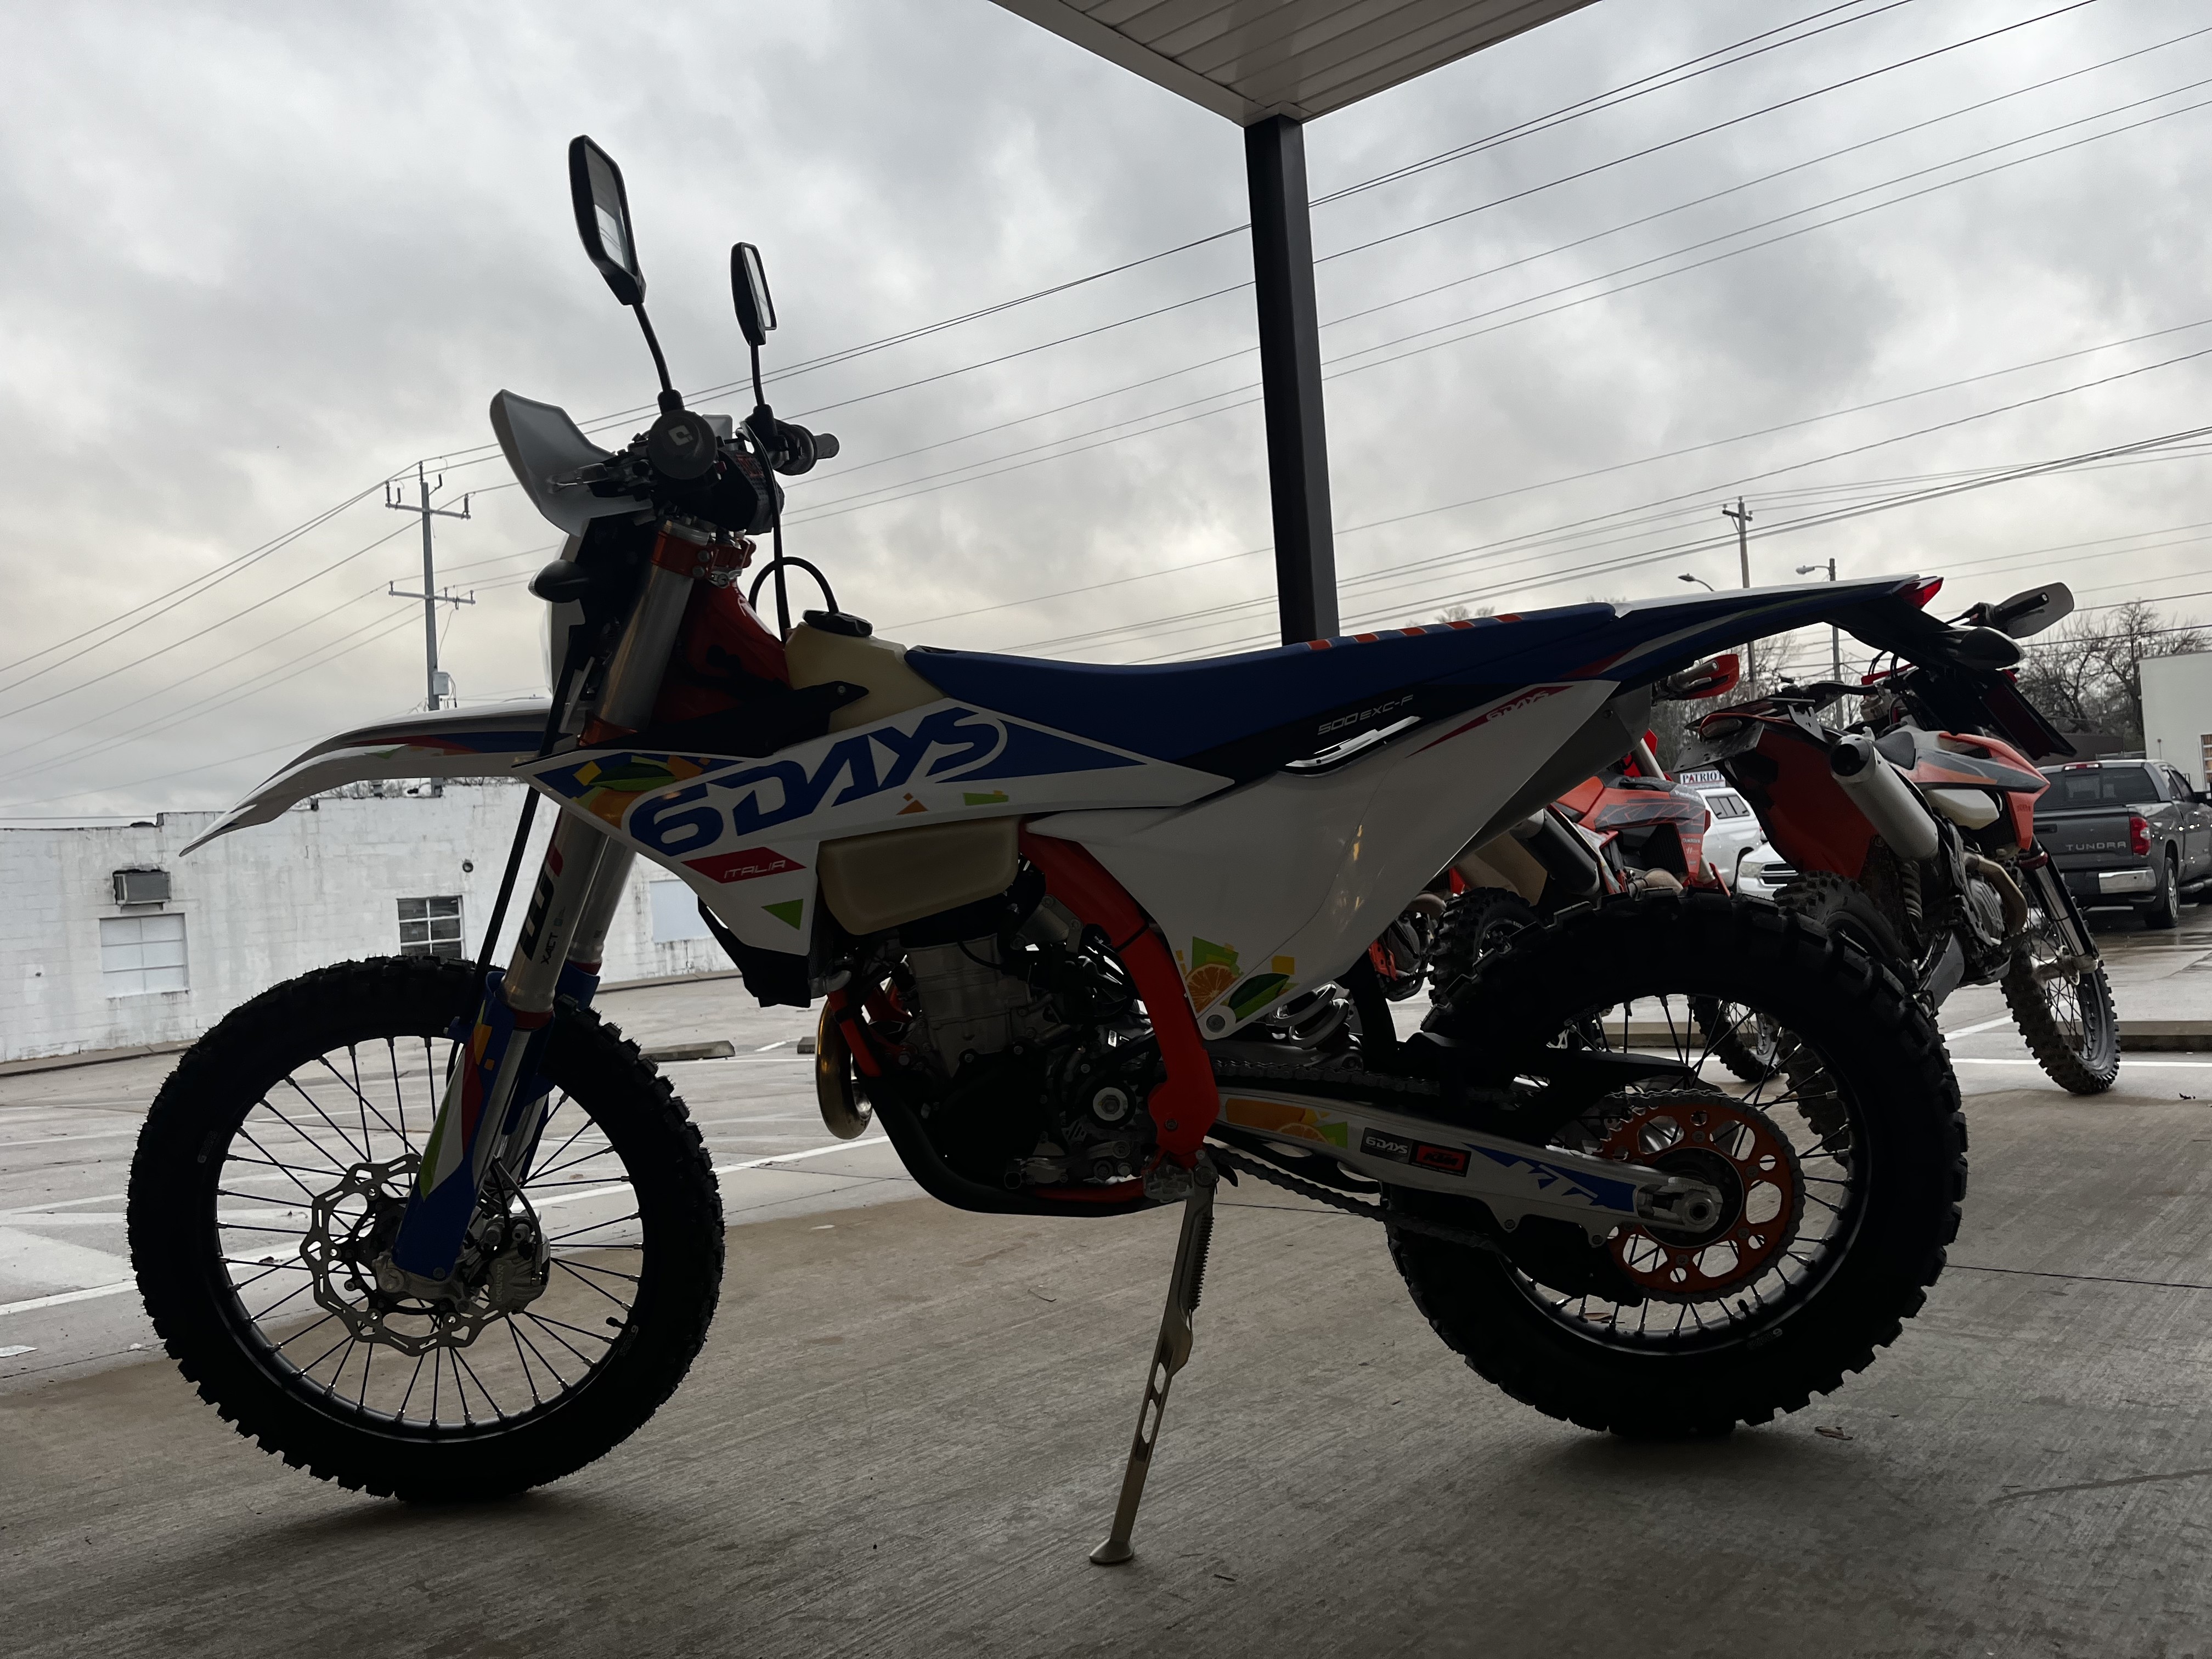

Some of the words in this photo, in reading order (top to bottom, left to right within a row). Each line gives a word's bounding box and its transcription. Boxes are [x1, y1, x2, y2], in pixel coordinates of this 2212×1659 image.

[1317, 713, 1358, 736] 500
[1359, 694, 1414, 721] EXC-F
[629, 707, 998, 857] 6DAYS
[2066, 841, 2126, 851] TUNDRA
[724, 859, 786, 879] ITALIA
[540, 932, 558, 964] XACT
[1365, 1136, 1408, 1154] 6DAYS
